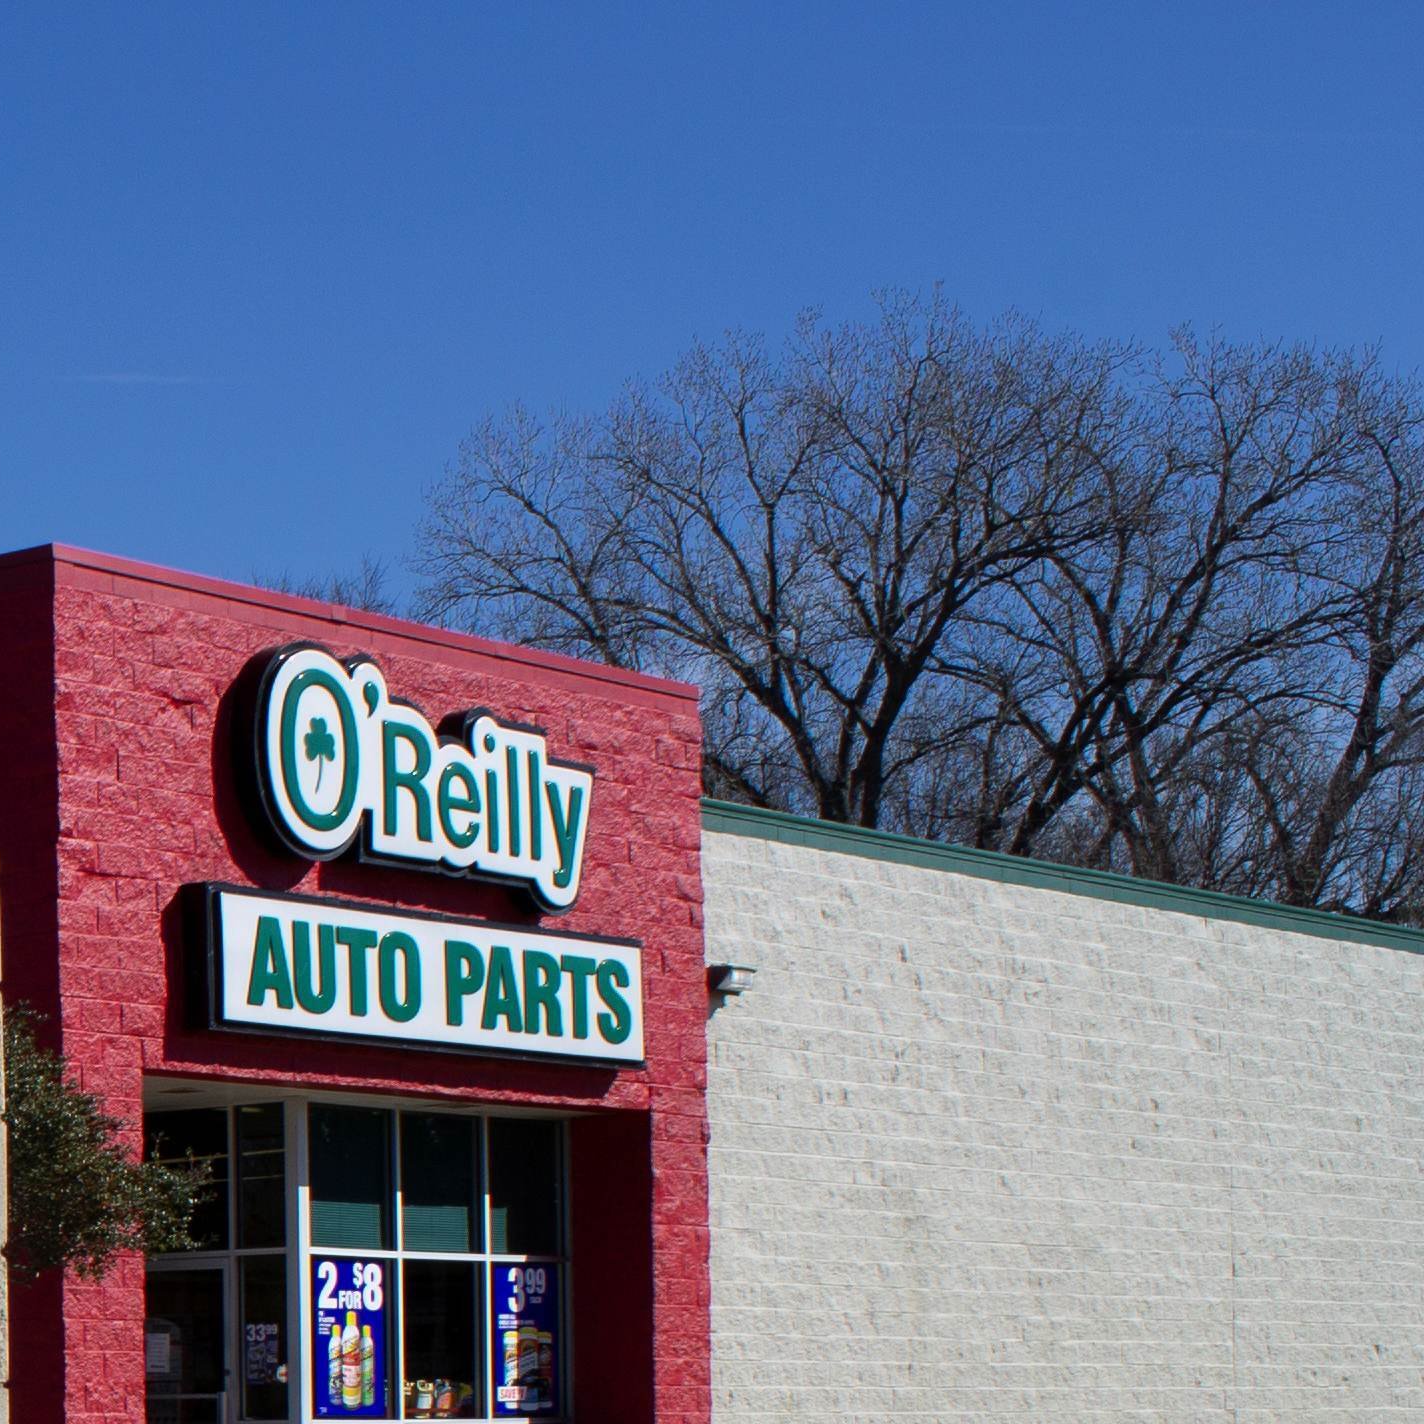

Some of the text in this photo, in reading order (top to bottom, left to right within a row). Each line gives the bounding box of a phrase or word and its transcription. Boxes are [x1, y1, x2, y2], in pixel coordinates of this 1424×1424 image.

[281, 668, 583, 888] O'Reilly
[248, 915, 631, 1045] AUTO PARTS
[318, 1262, 338, 1309] 2
[338, 1290, 362, 1309] FOR
